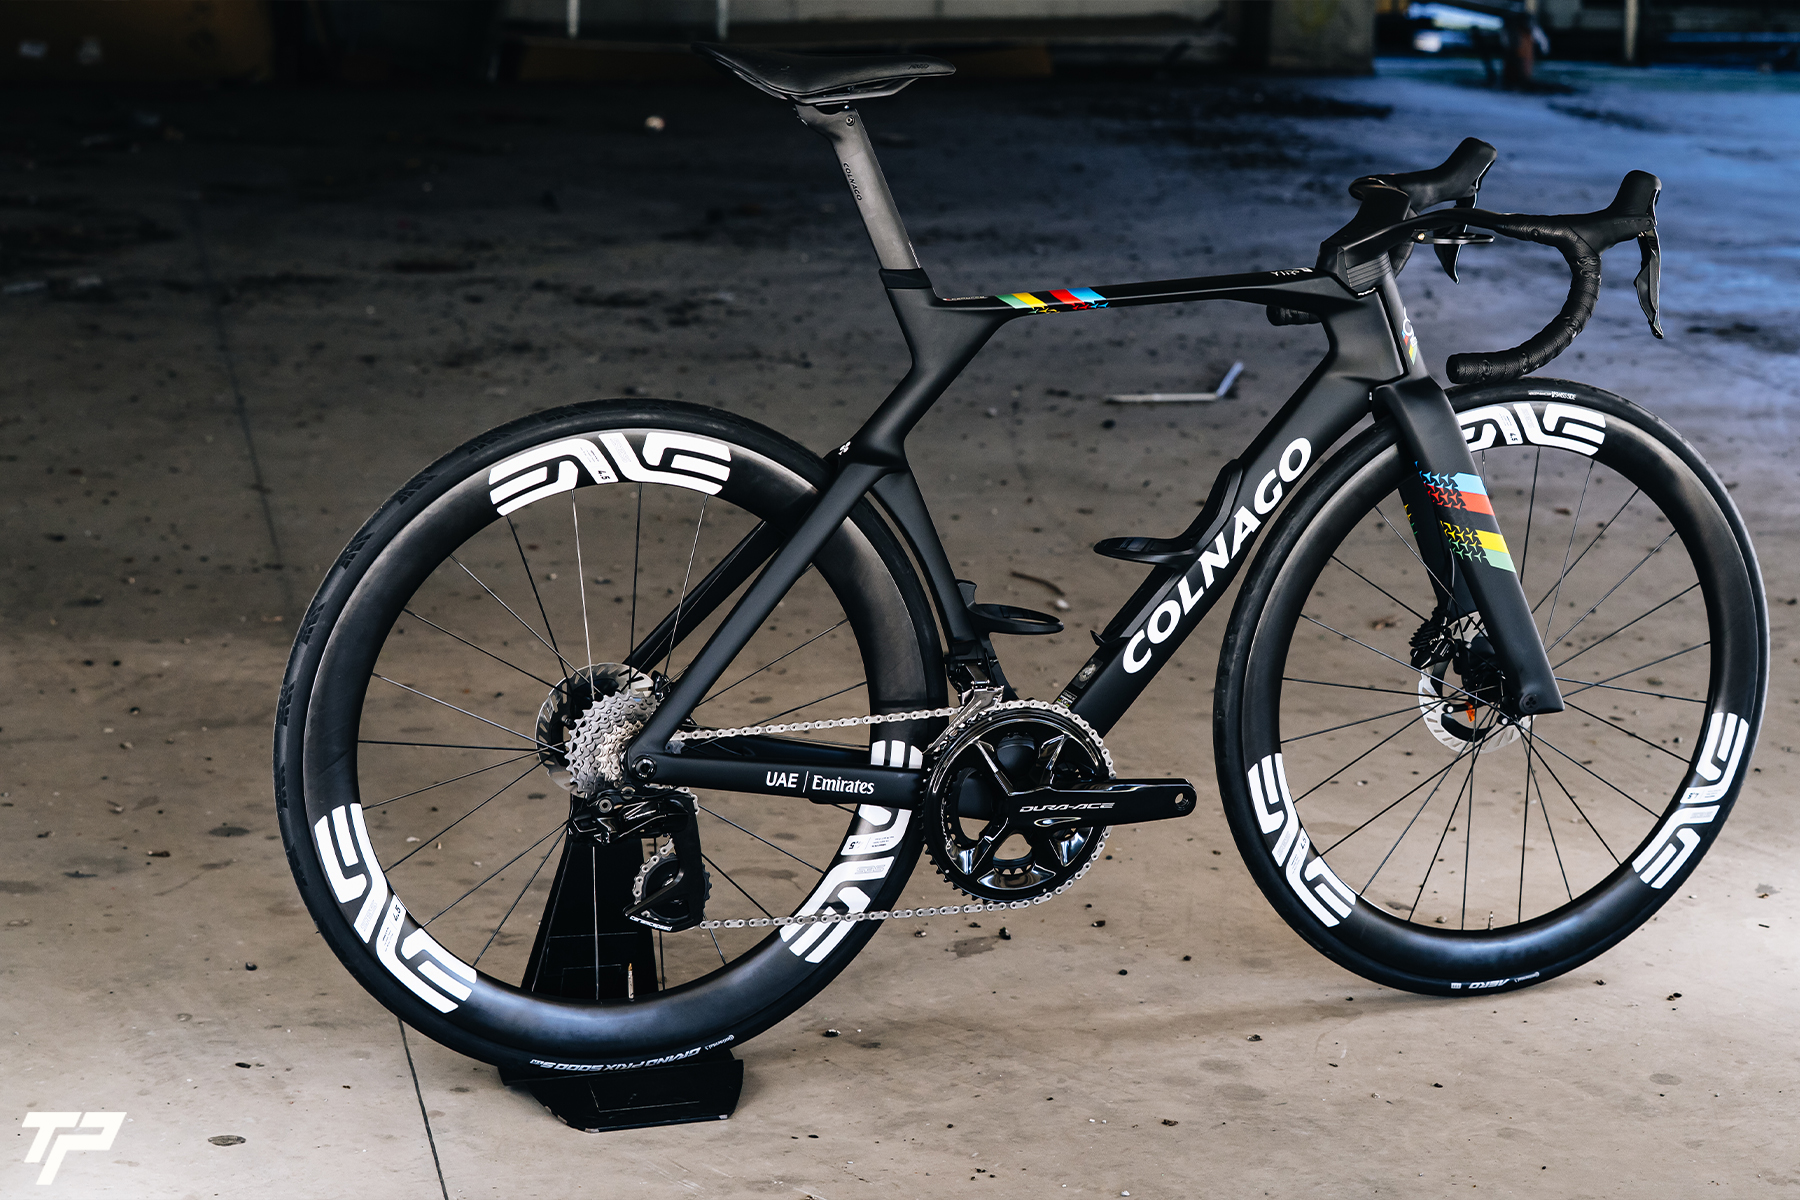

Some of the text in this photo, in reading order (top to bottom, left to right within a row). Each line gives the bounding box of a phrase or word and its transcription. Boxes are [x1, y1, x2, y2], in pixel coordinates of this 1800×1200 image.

[843, 162, 863, 201] COLNAGO
[597, 469, 611, 480] 4.5
[1122, 437, 1312, 674] COLNAGO
[766, 770, 875, 796] UAE Emirates
[1019, 801, 1116, 814] DURA-ACE
[1468, 978, 1510, 989] AERO
[644, 1046, 702, 1068] GRAND
[555, 1062, 604, 1072] 5000
[603, 1060, 646, 1072] PRIX
